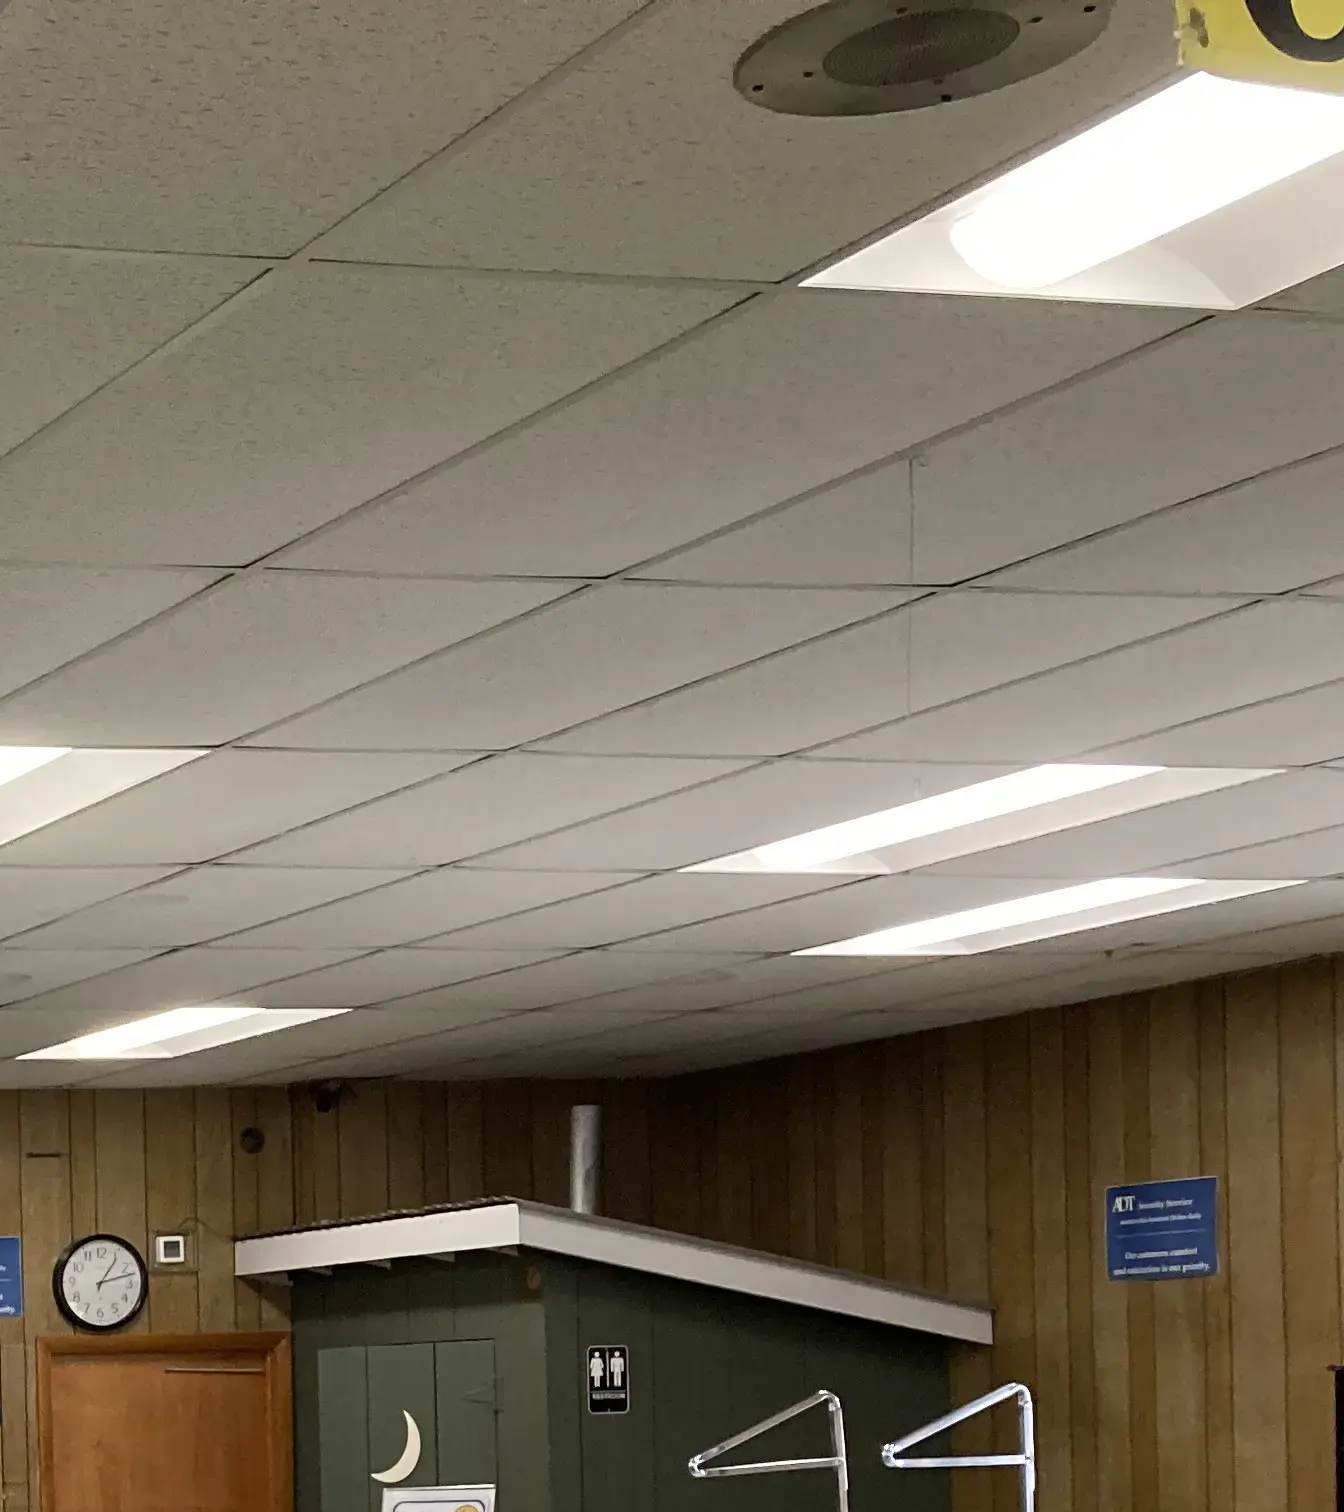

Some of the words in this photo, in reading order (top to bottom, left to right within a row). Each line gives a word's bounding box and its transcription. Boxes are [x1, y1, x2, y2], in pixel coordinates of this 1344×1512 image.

[1112, 1195, 1136, 1213] ADT
[84, 1251, 92, 1262] 11
[96, 1247, 107, 1259] 12
[73, 1262, 84, 1273] 10
[69, 1276, 76, 1287] 9
[73, 1291, 81, 1303] 8
[120, 1292, 129, 1304] 4
[84, 1302, 91, 1314] 7
[96, 1307, 105, 1318] 6
[111, 1302, 119, 1314] 5
